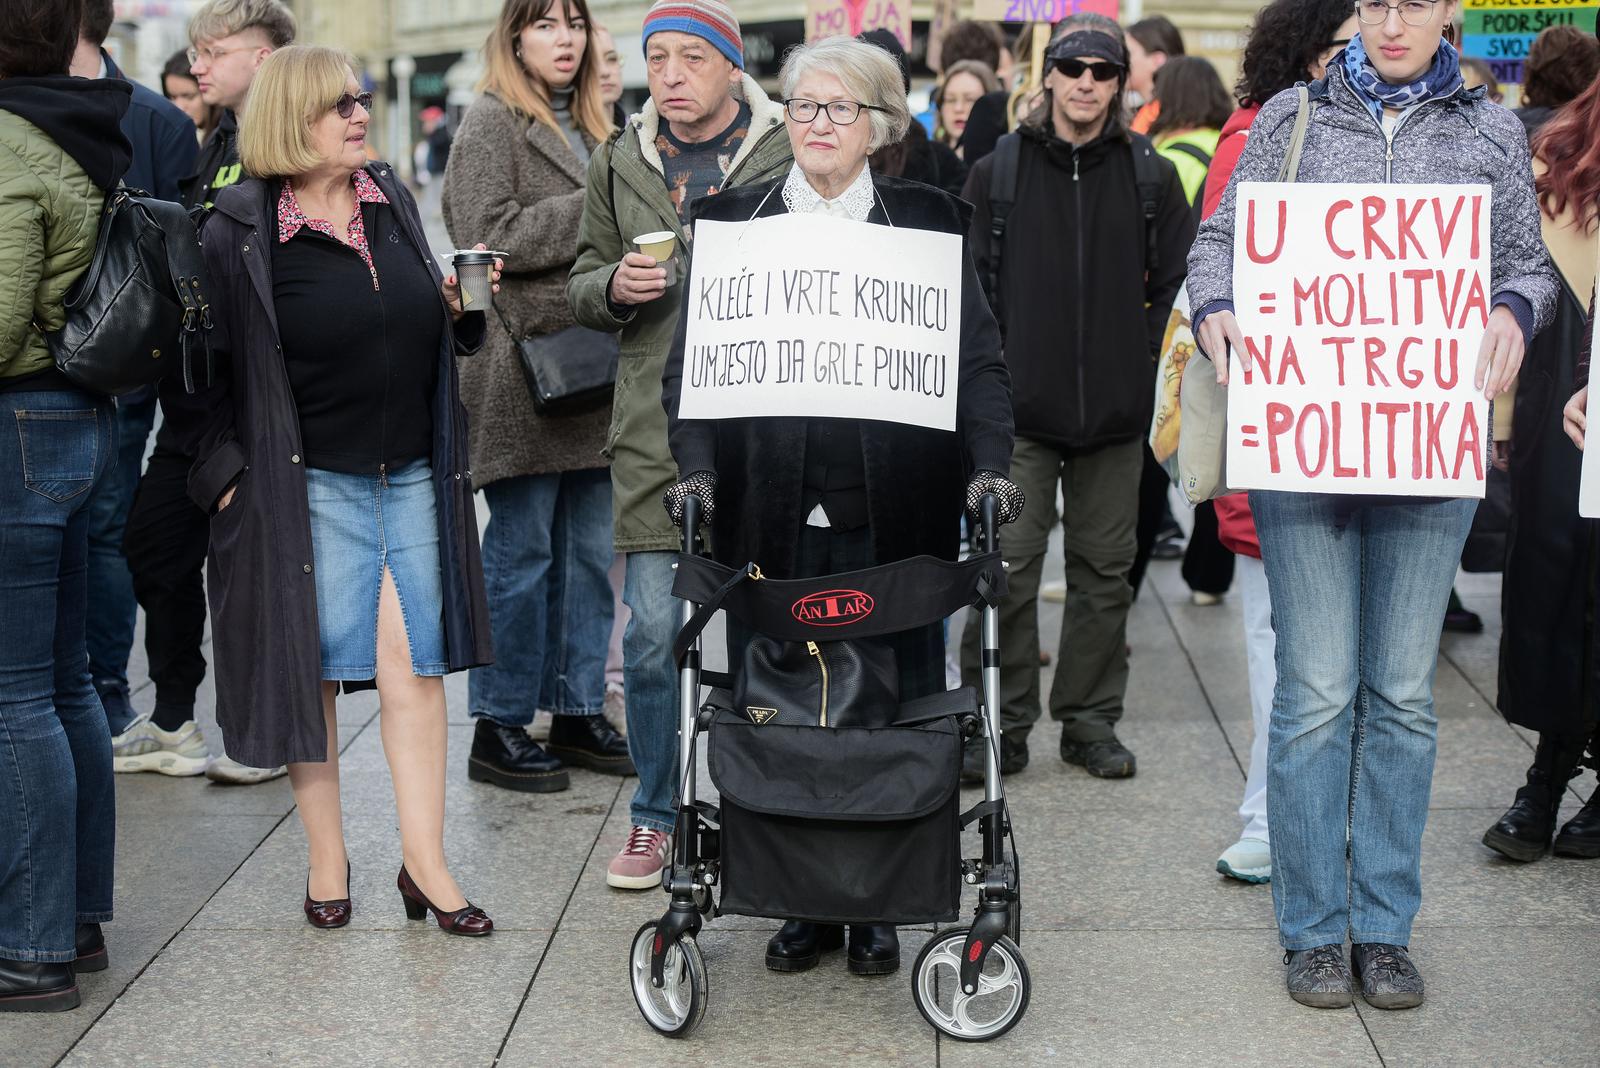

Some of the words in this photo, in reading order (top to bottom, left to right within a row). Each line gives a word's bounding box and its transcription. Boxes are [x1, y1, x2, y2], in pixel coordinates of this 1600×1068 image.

[1246, 199, 1287, 265] U
[1325, 195, 1483, 260] CRKVI
[699, 266, 755, 321] KLEČE
[764, 271, 771, 316] I
[783, 269, 842, 316] VRTE
[854, 274, 948, 332] KRUNICU
[1293, 269, 1490, 330] MOLITVA
[691, 340, 767, 388] UMJESTO
[775, 339, 805, 384] DA
[813, 340, 865, 386] GRLE
[874, 345, 946, 398] PUNICU
[1243, 335, 1306, 386] NA
[1321, 336, 1459, 391] TRGU
